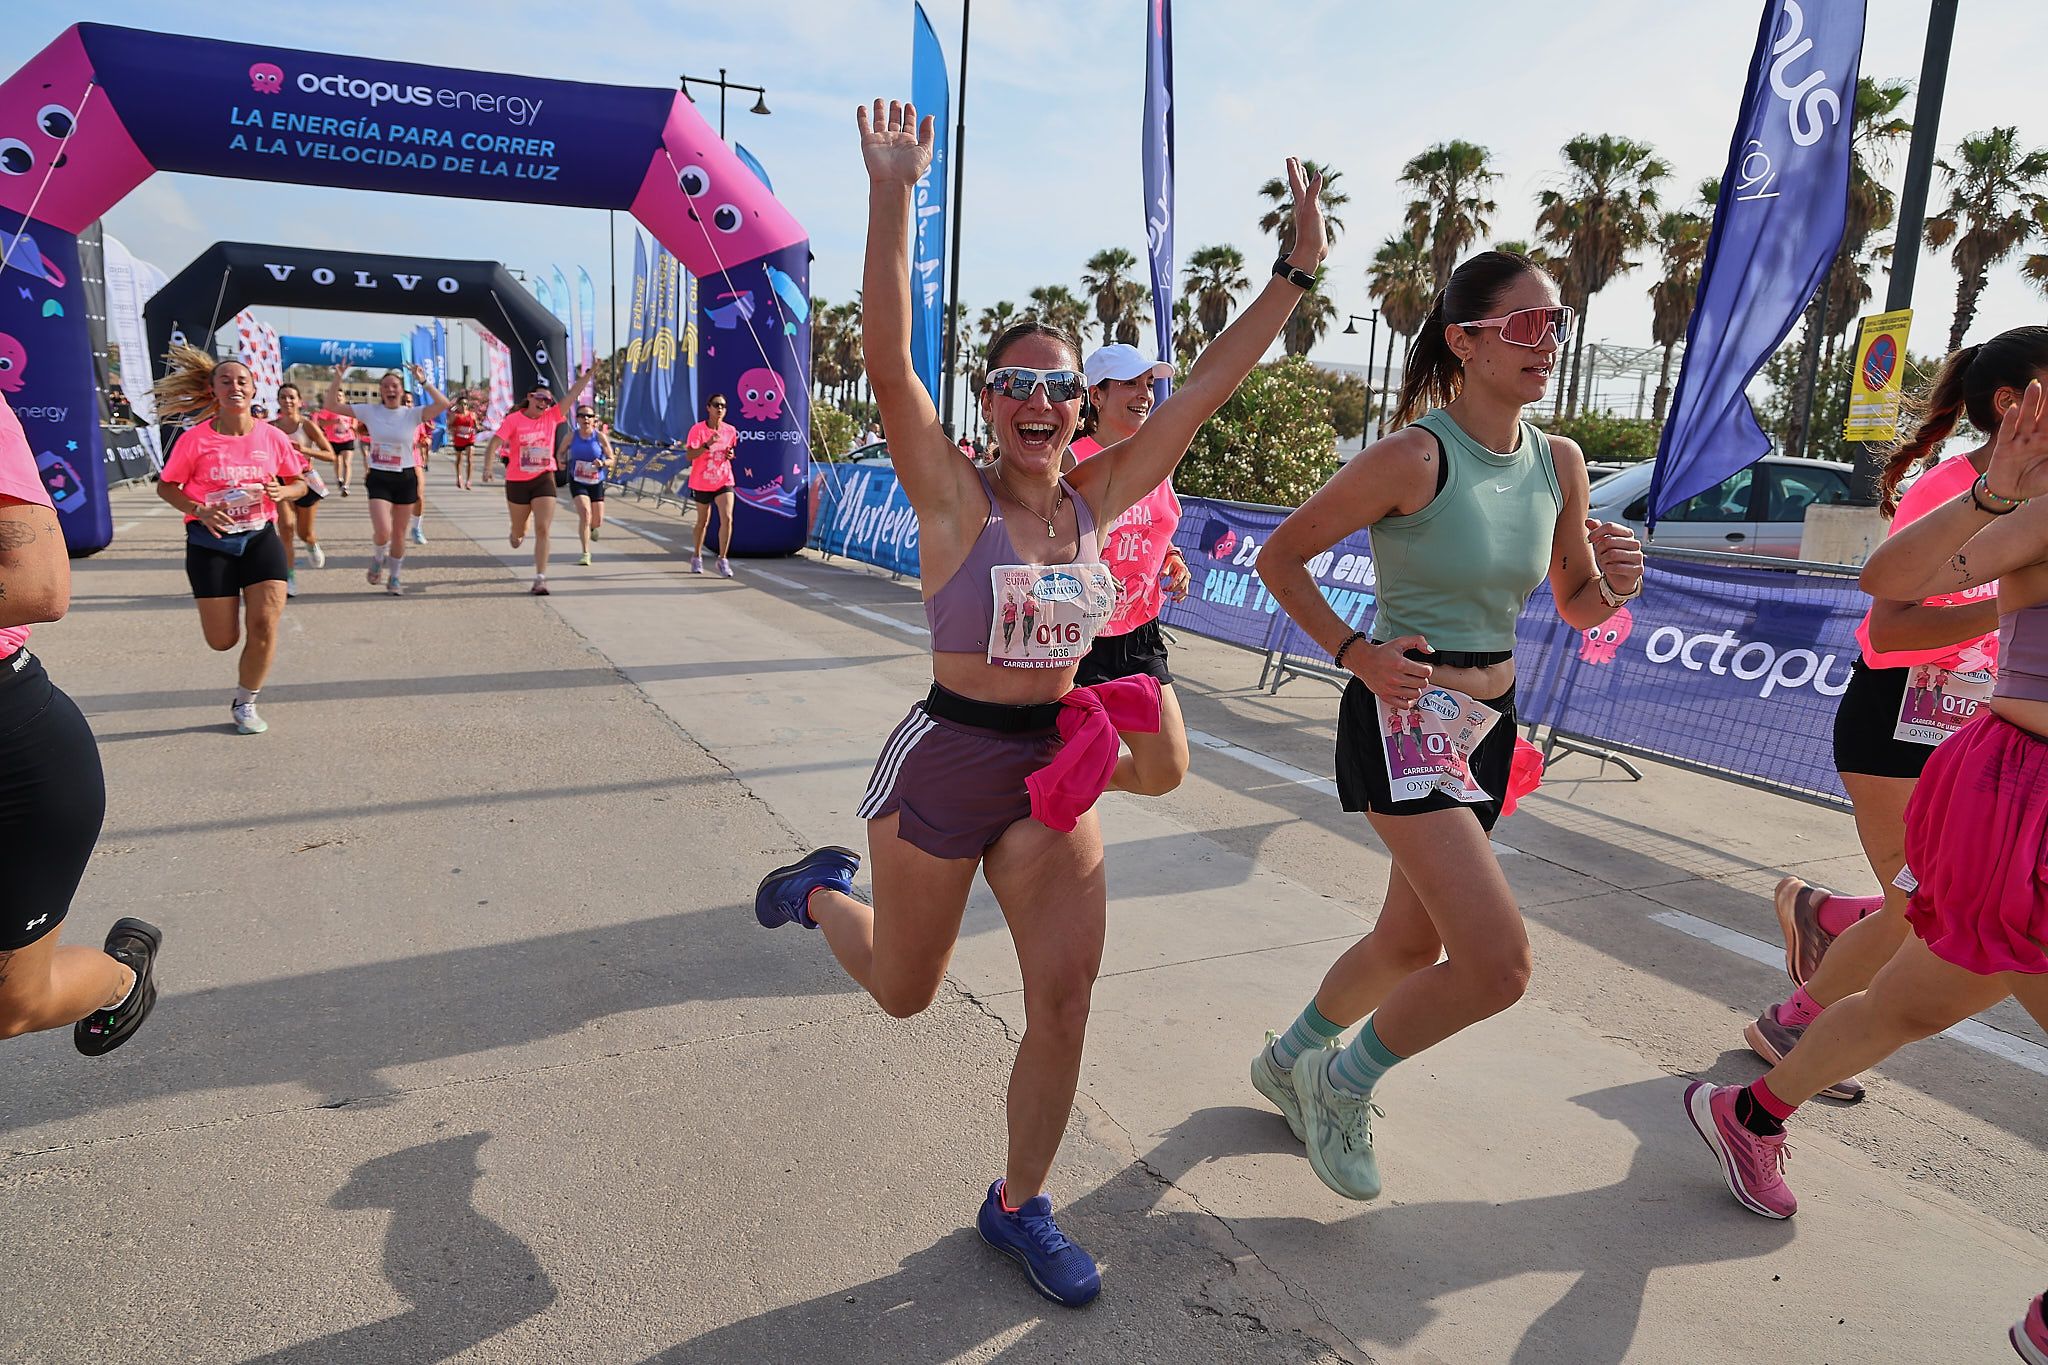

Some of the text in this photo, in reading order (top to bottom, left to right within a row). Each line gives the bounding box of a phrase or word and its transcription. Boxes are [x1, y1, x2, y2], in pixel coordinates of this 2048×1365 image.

[297, 72, 544, 126] octopus energy
[230, 107, 556, 158] LA ENERGÍA PARA CORRER
[229, 134, 560, 182] A LA VELOCIDAD DE LA LUZ
[264, 264, 460, 294] VOLVO
[210, 465, 264, 481] CARRERA
[227, 506, 250, 517] 016
[832, 470, 920, 562] Marlene
[1005, 577, 1031, 586] SUMA
[1202, 568, 1250, 608] PARA
[1036, 622, 1081, 645] 016
[1048, 648, 1069, 658] 4036
[1645, 625, 1856, 698] octopu
[1003, 660, 1034, 669] CARRERA
[1036, 660, 1046, 669] DE
[1046, 661, 1054, 669] LA
[1942, 695, 1979, 716] 016
[1912, 717, 1935, 726] CARRERA
[1909, 728, 1944, 741] OYSHO
[1403, 765, 1434, 776] CARRERA
[1435, 765, 1445, 773] DE
